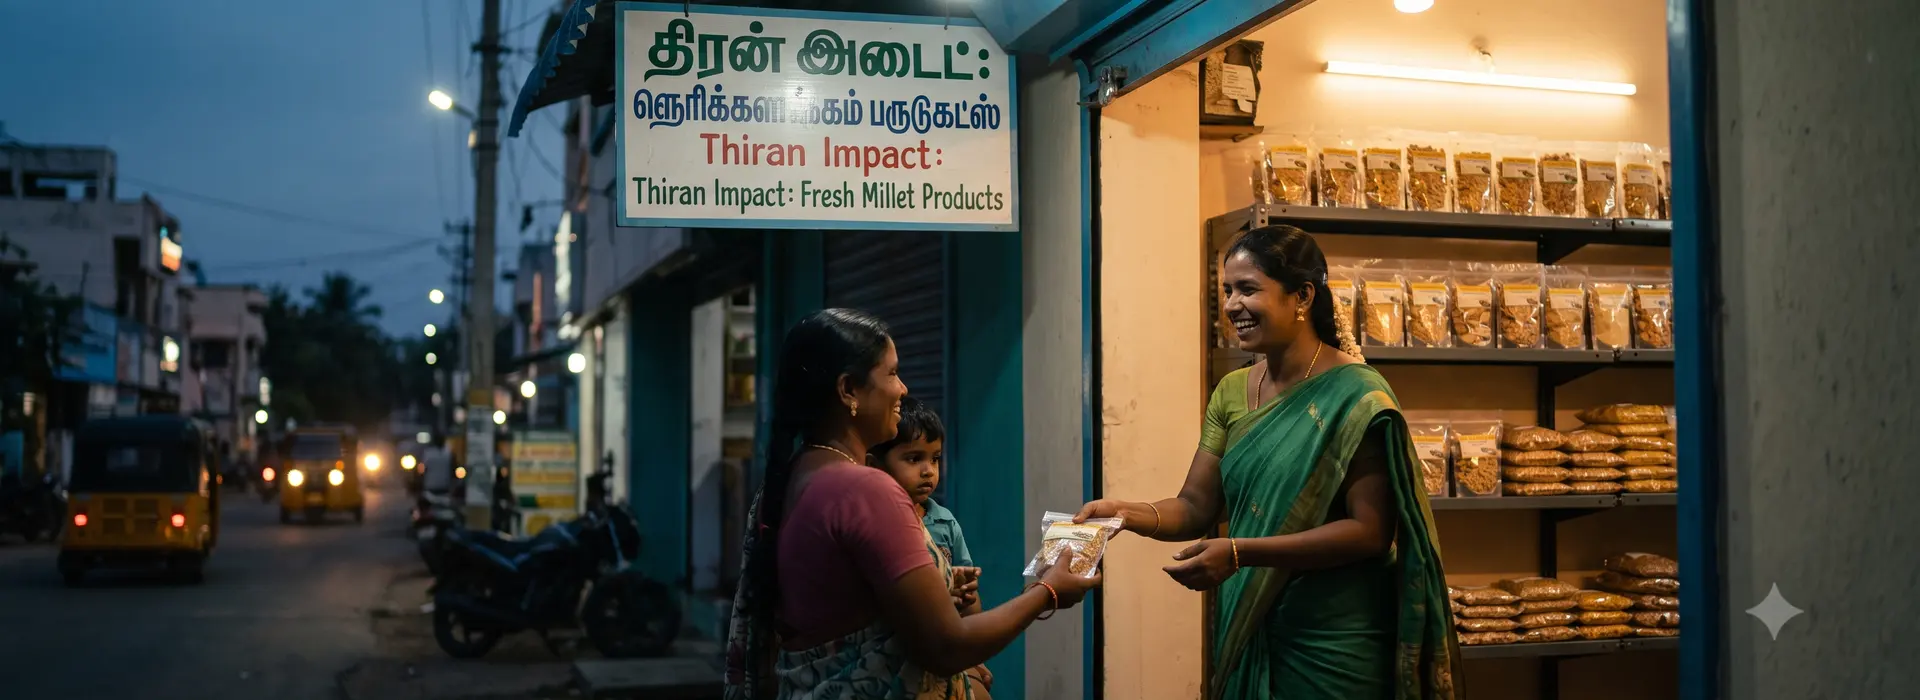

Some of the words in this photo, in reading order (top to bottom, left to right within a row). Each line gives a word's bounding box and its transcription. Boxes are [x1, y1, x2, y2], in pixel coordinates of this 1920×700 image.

[644, 18, 787, 82] திரன்
[699, 132, 806, 167] Thiran
[824, 136, 943, 177] Impact:
[632, 176, 706, 206] Thiran
[714, 180, 794, 214] Impact:
[801, 180, 855, 209] Fresh
[862, 181, 916, 210] Millet
[922, 183, 1004, 211] Products
